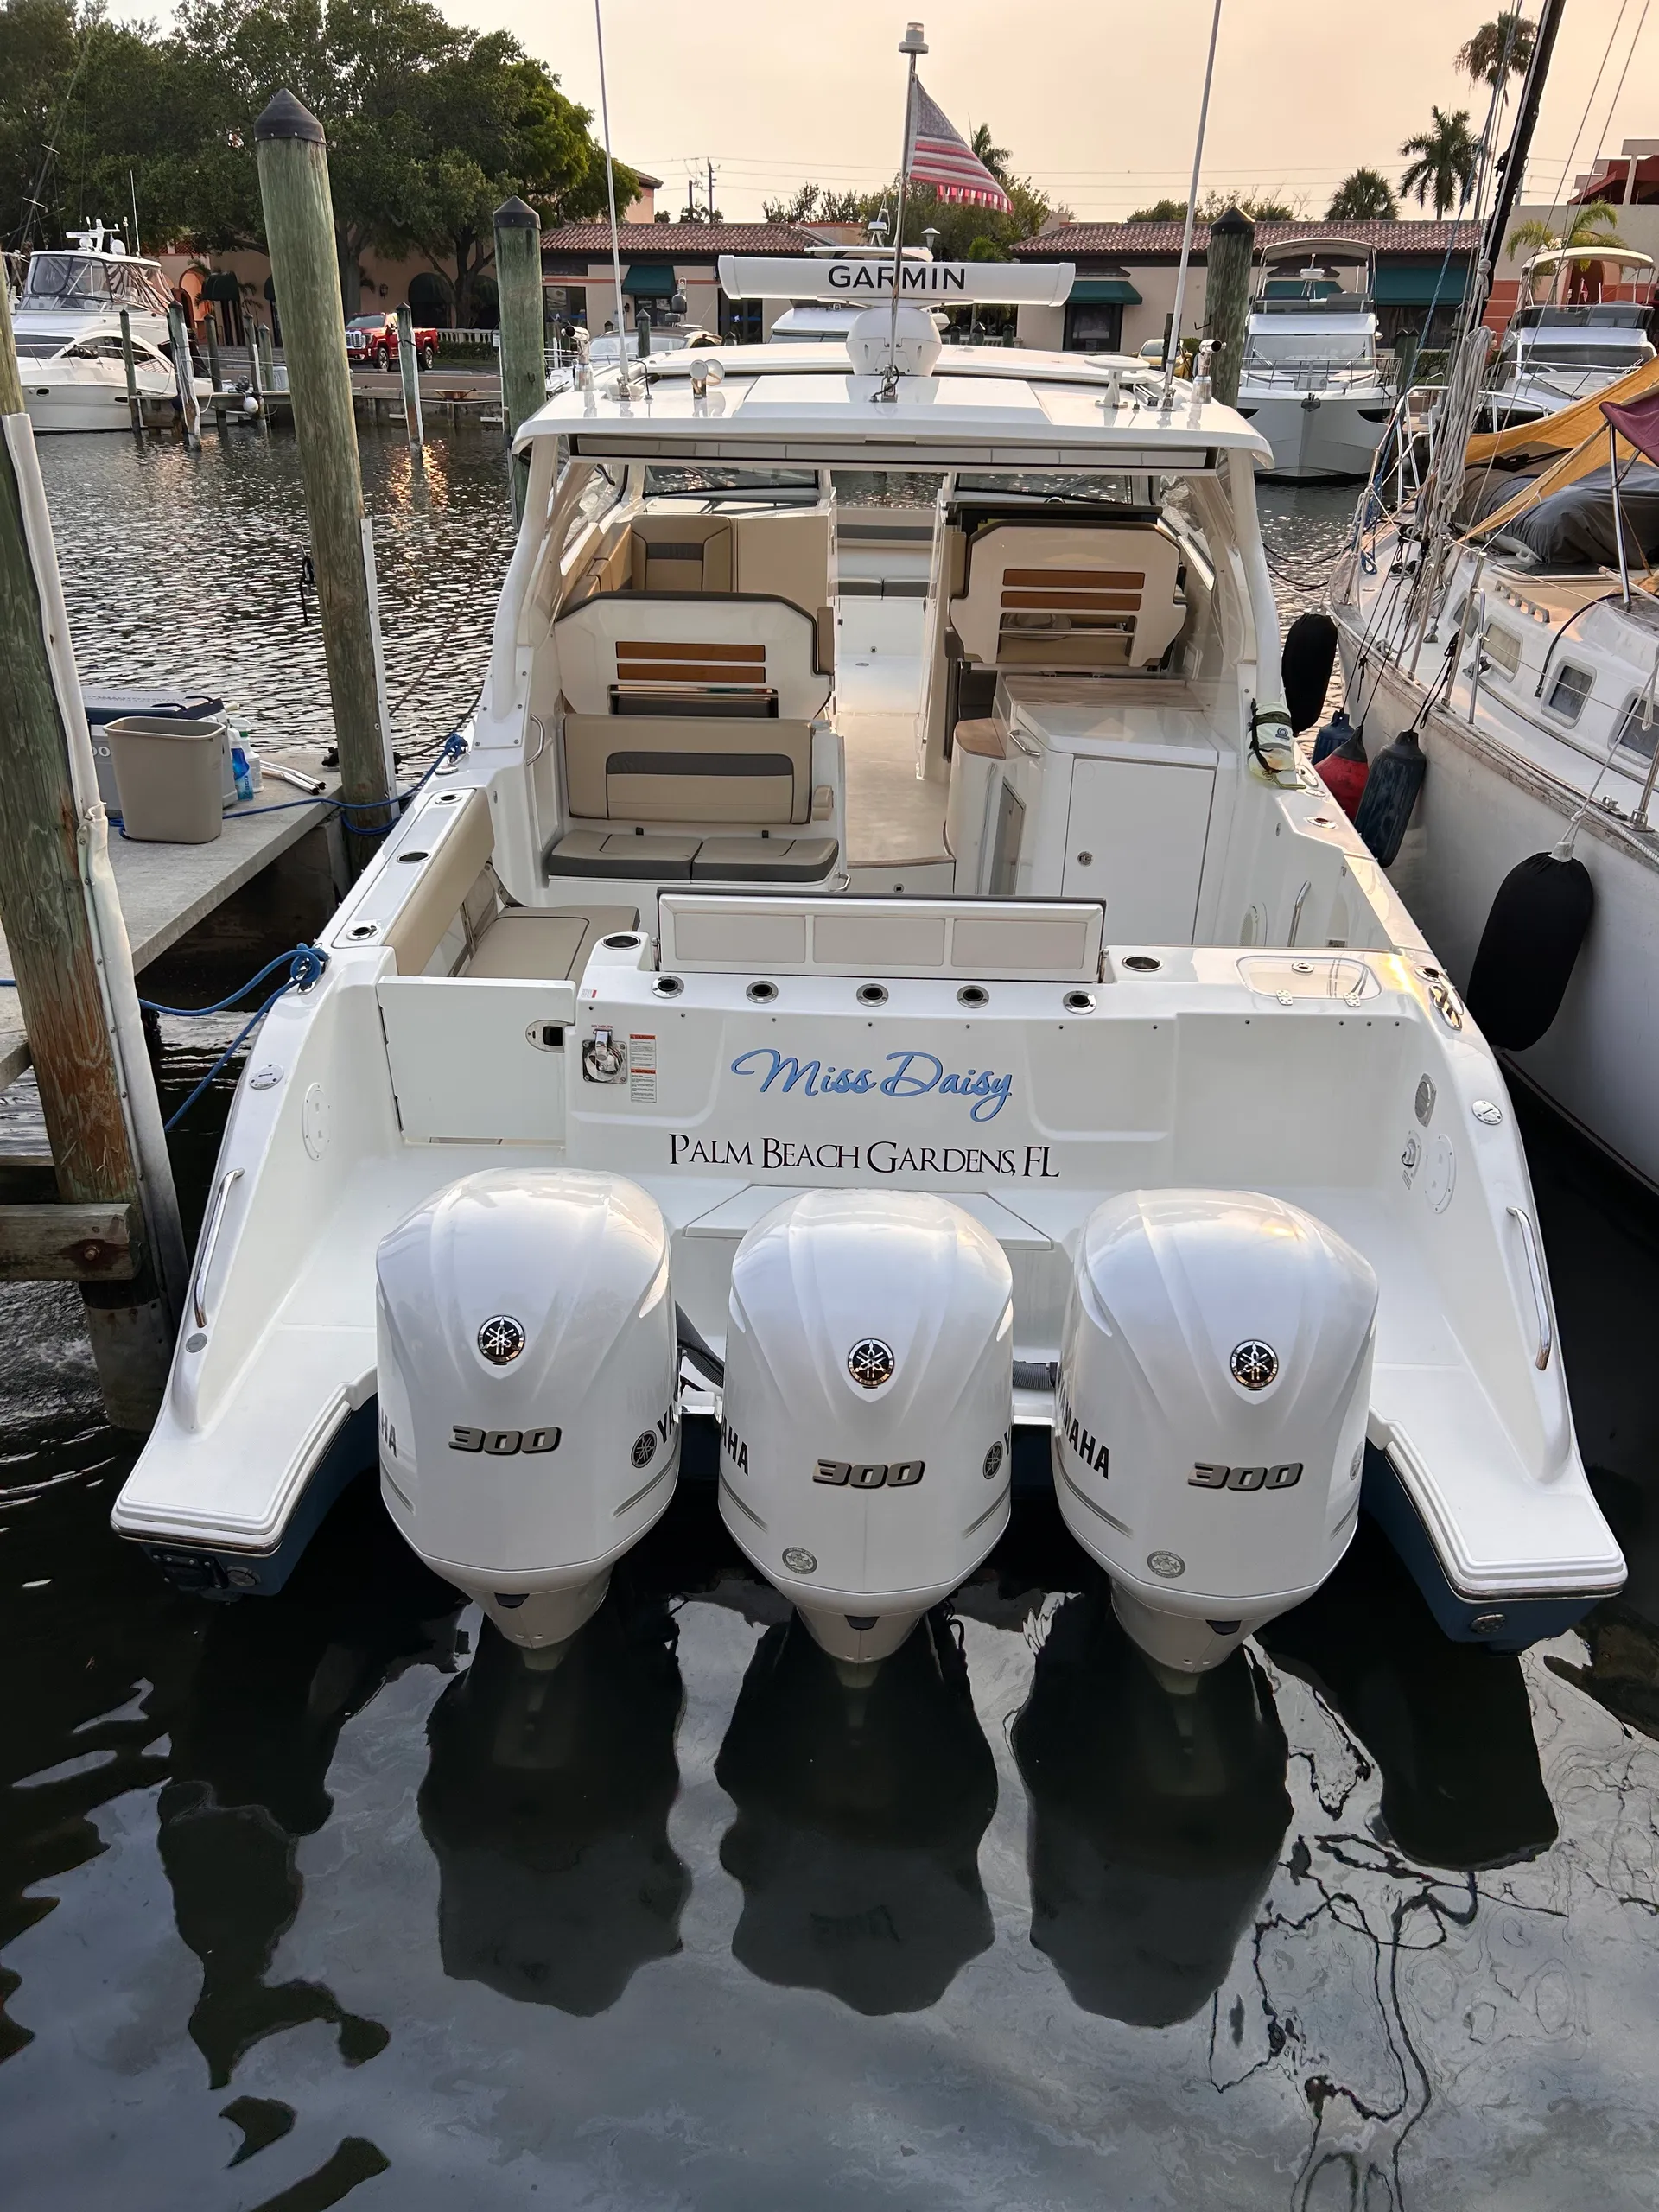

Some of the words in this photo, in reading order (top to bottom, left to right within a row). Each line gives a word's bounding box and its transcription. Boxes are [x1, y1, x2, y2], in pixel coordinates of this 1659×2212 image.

[828, 265, 965, 290] GARMIN
[731, 1048, 877, 1096] Miss
[880, 1051, 1013, 1122] Daisy
[669, 1133, 755, 1166] PALM
[760, 1137, 861, 1169] BEACH
[1020, 1145, 1060, 1178] FL
[448, 1425, 563, 1456] 300
[812, 1459, 925, 1490] 300
[1187, 1462, 1304, 1492] 300
